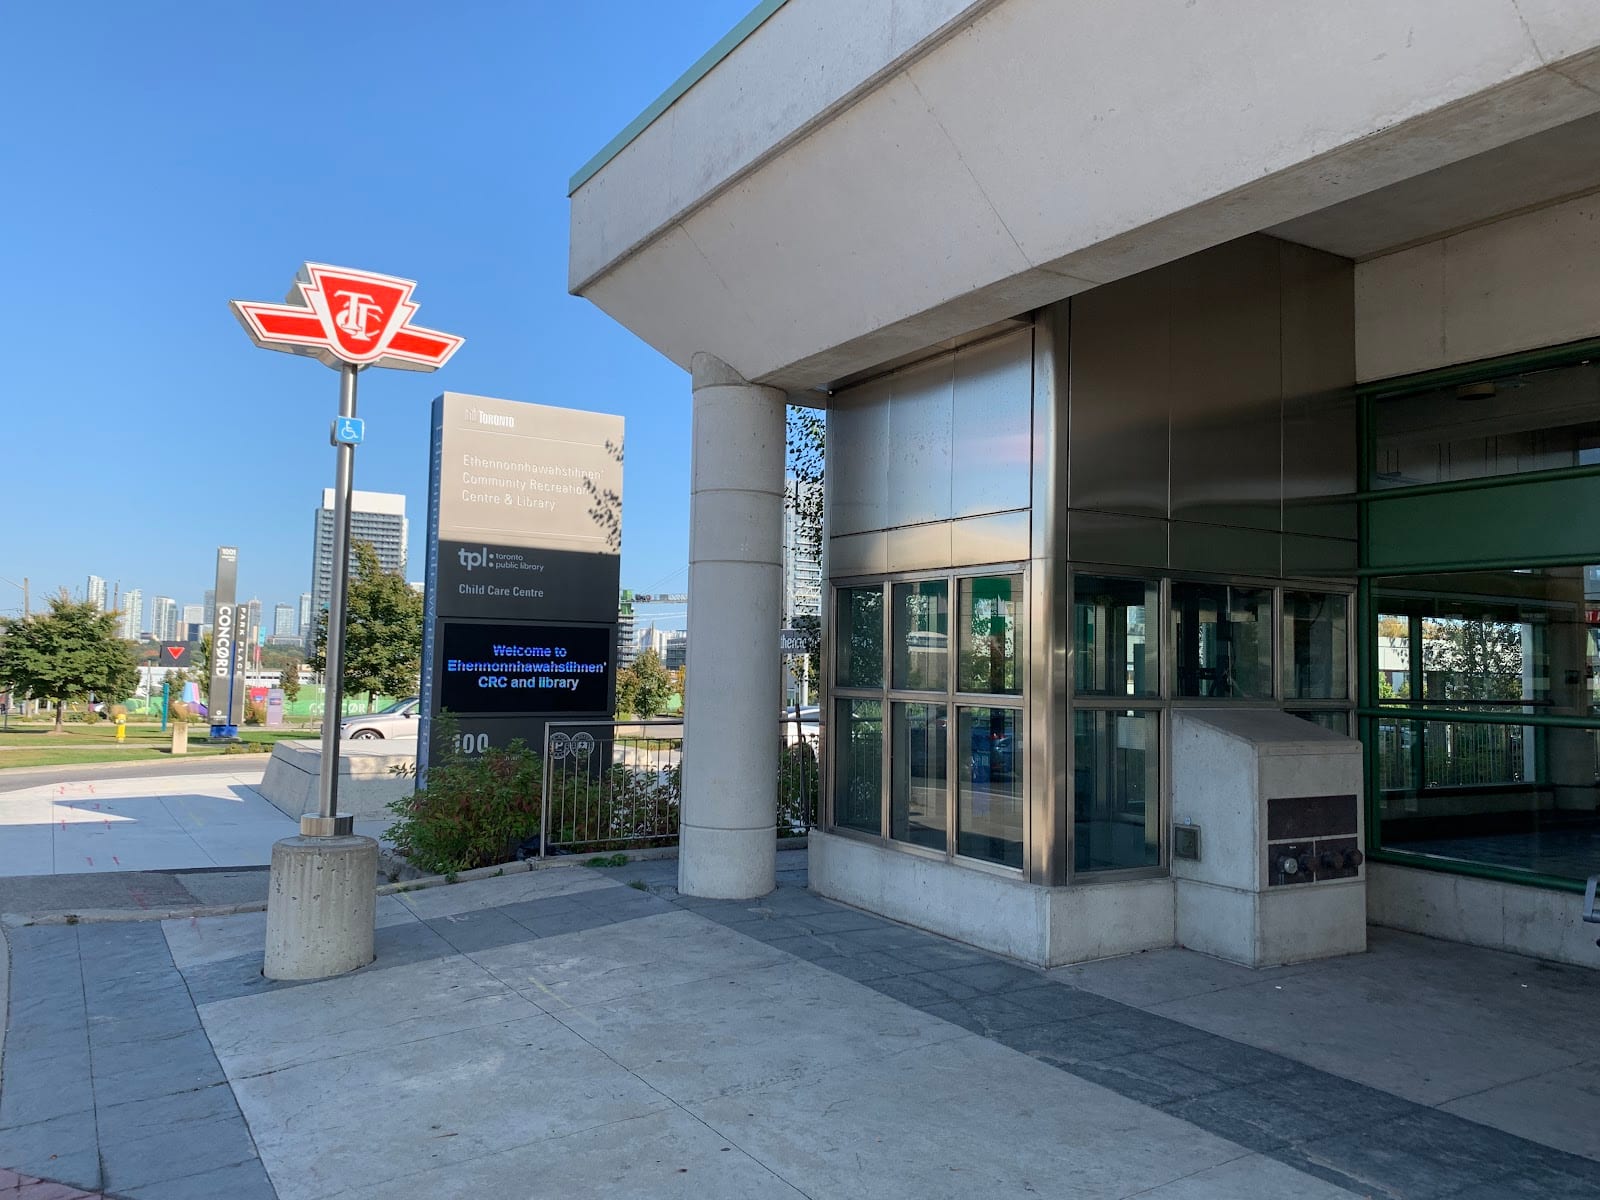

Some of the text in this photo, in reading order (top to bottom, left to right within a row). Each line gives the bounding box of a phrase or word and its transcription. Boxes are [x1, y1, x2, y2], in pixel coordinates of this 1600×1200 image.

[479, 410, 514, 428] TORONTO
[462, 472, 590, 496] Community Recreation
[462, 490, 556, 512] Centre & Library
[495, 553, 524, 561] toronto
[495, 562, 544, 572] public library
[459, 583, 544, 598] Child Care Centre
[236, 607, 247, 676] PARK PLACE
[493, 644, 567, 657] Welcome to
[478, 676, 580, 691] CRC and library
